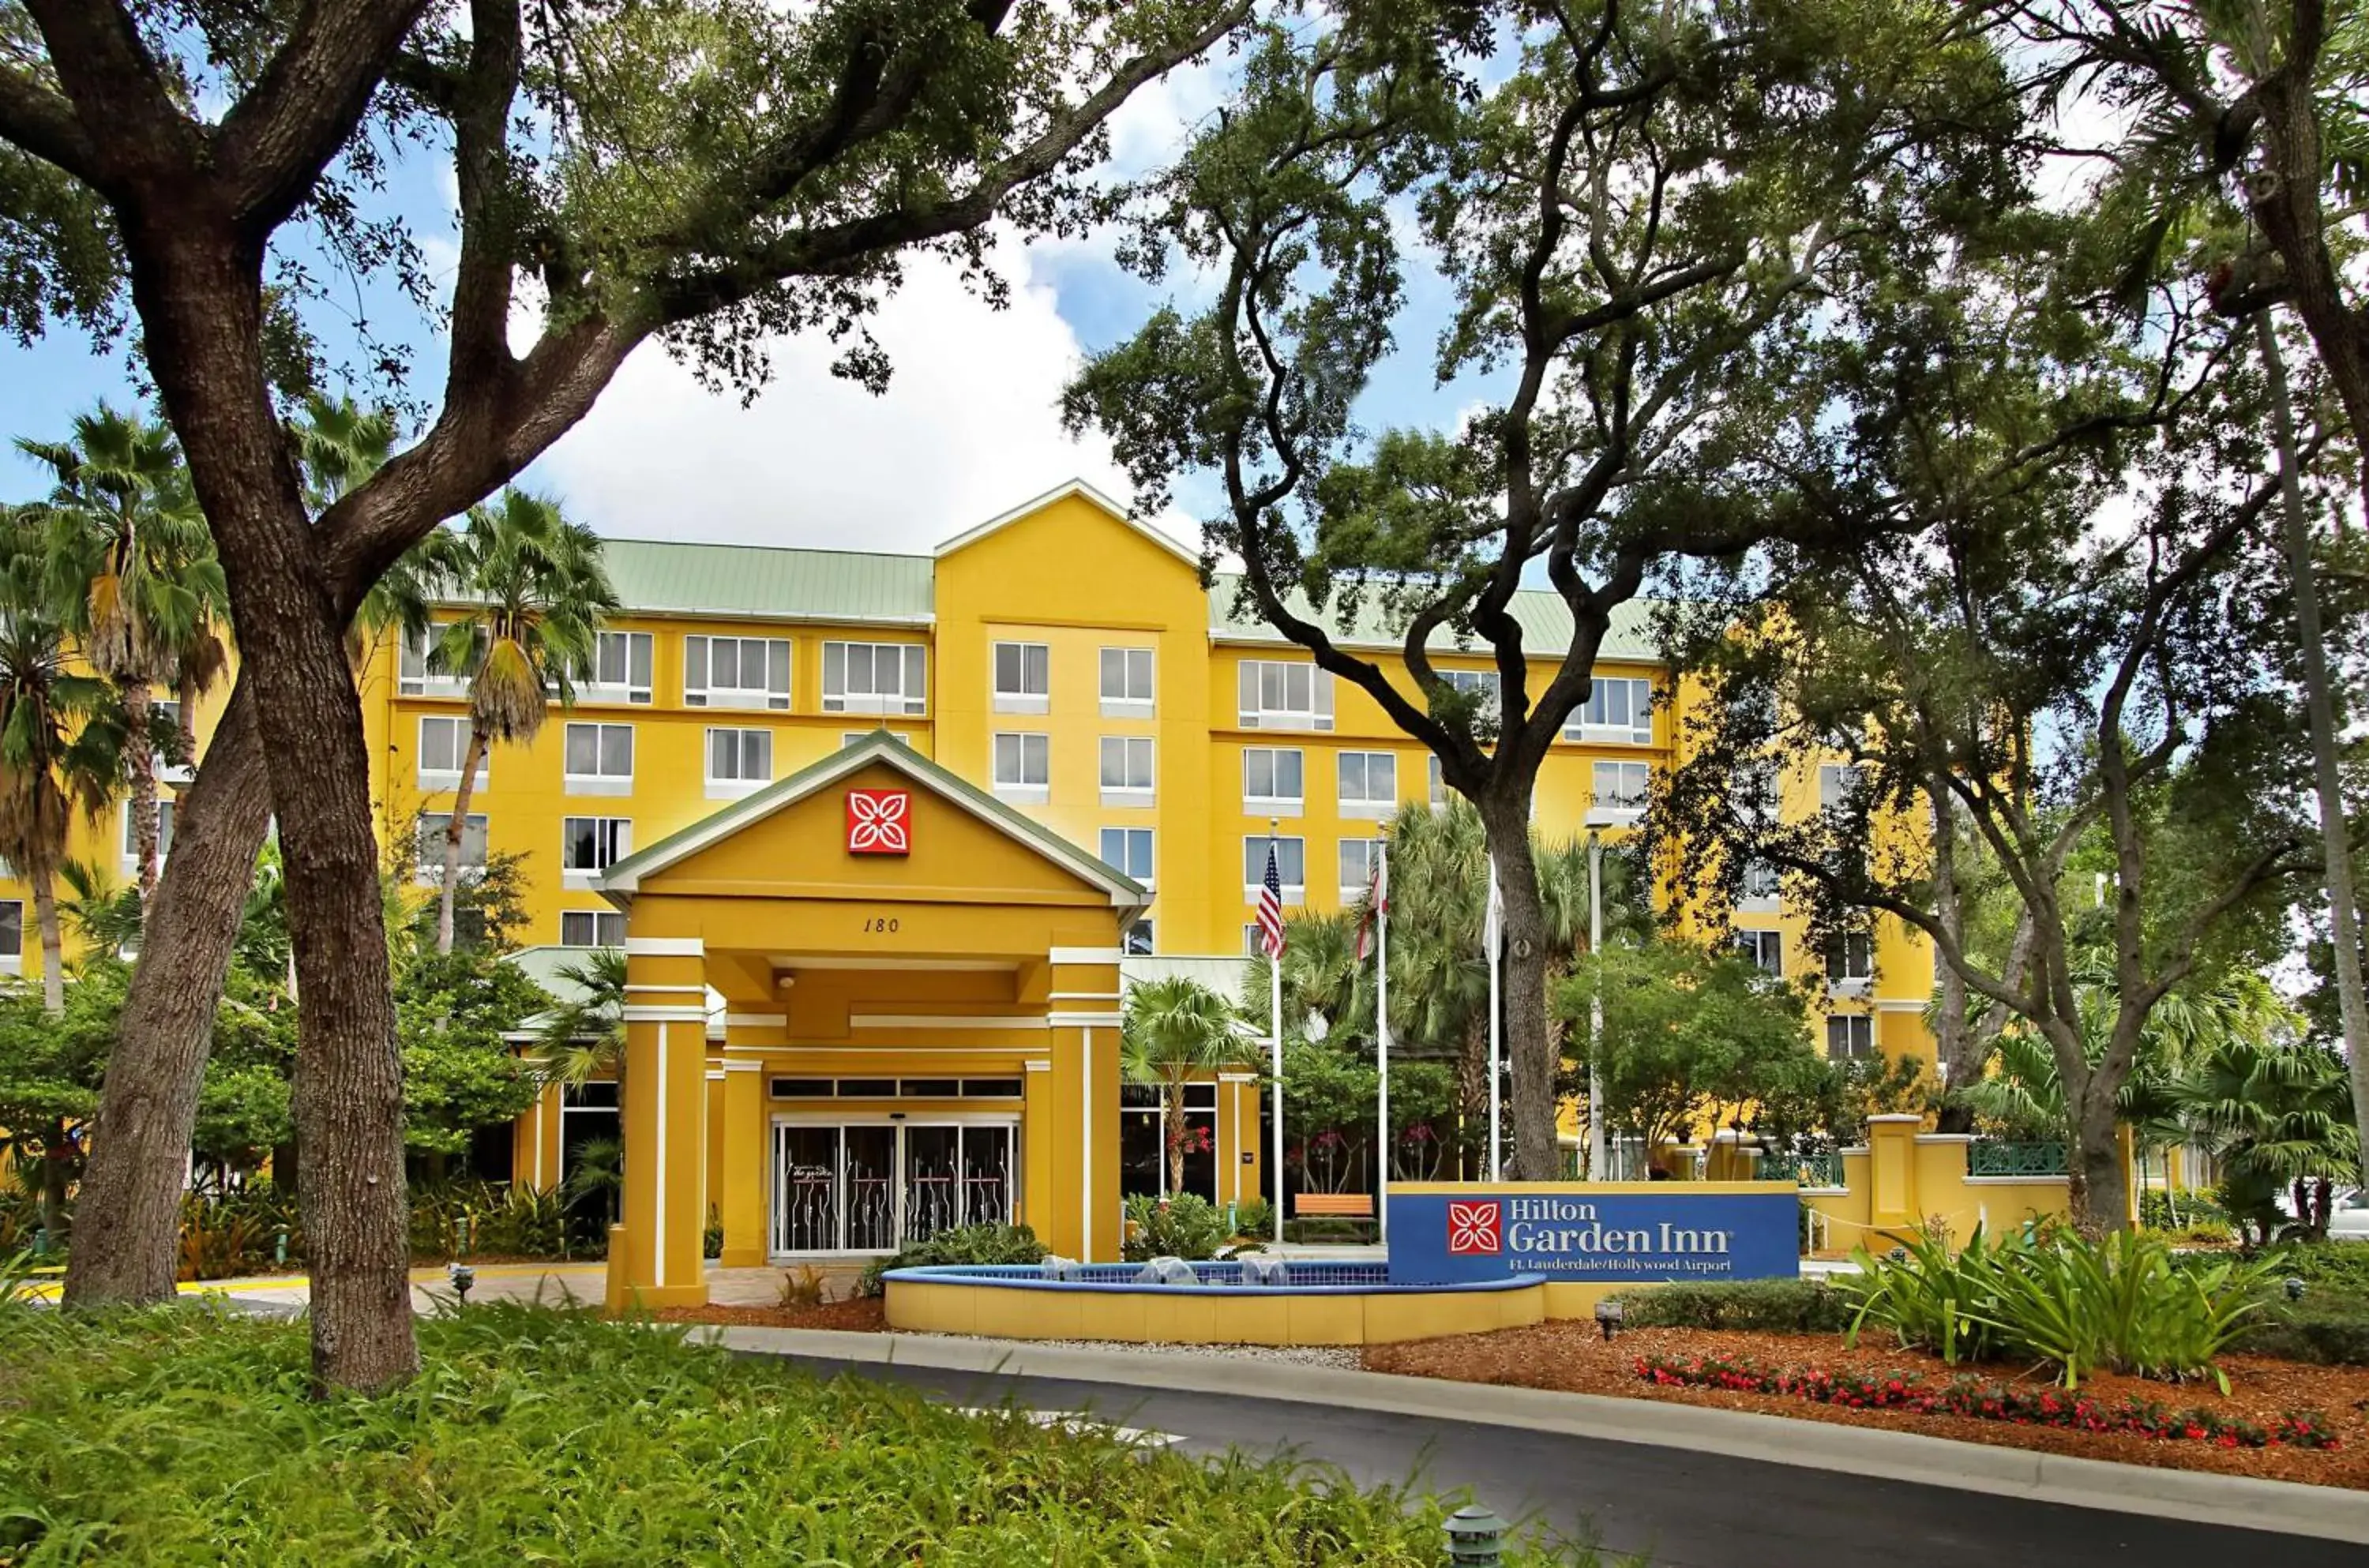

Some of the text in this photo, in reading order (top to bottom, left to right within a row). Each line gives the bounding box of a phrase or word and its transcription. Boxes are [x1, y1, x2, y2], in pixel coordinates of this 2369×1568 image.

[864, 918, 899, 932] 180
[1509, 1199, 1597, 1221] Hilton
[1508, 1221, 1729, 1253] Garden Inn
[1527, 1257, 1680, 1274] Lauderdale/Hollywood
[1683, 1259, 1732, 1274] Airport
